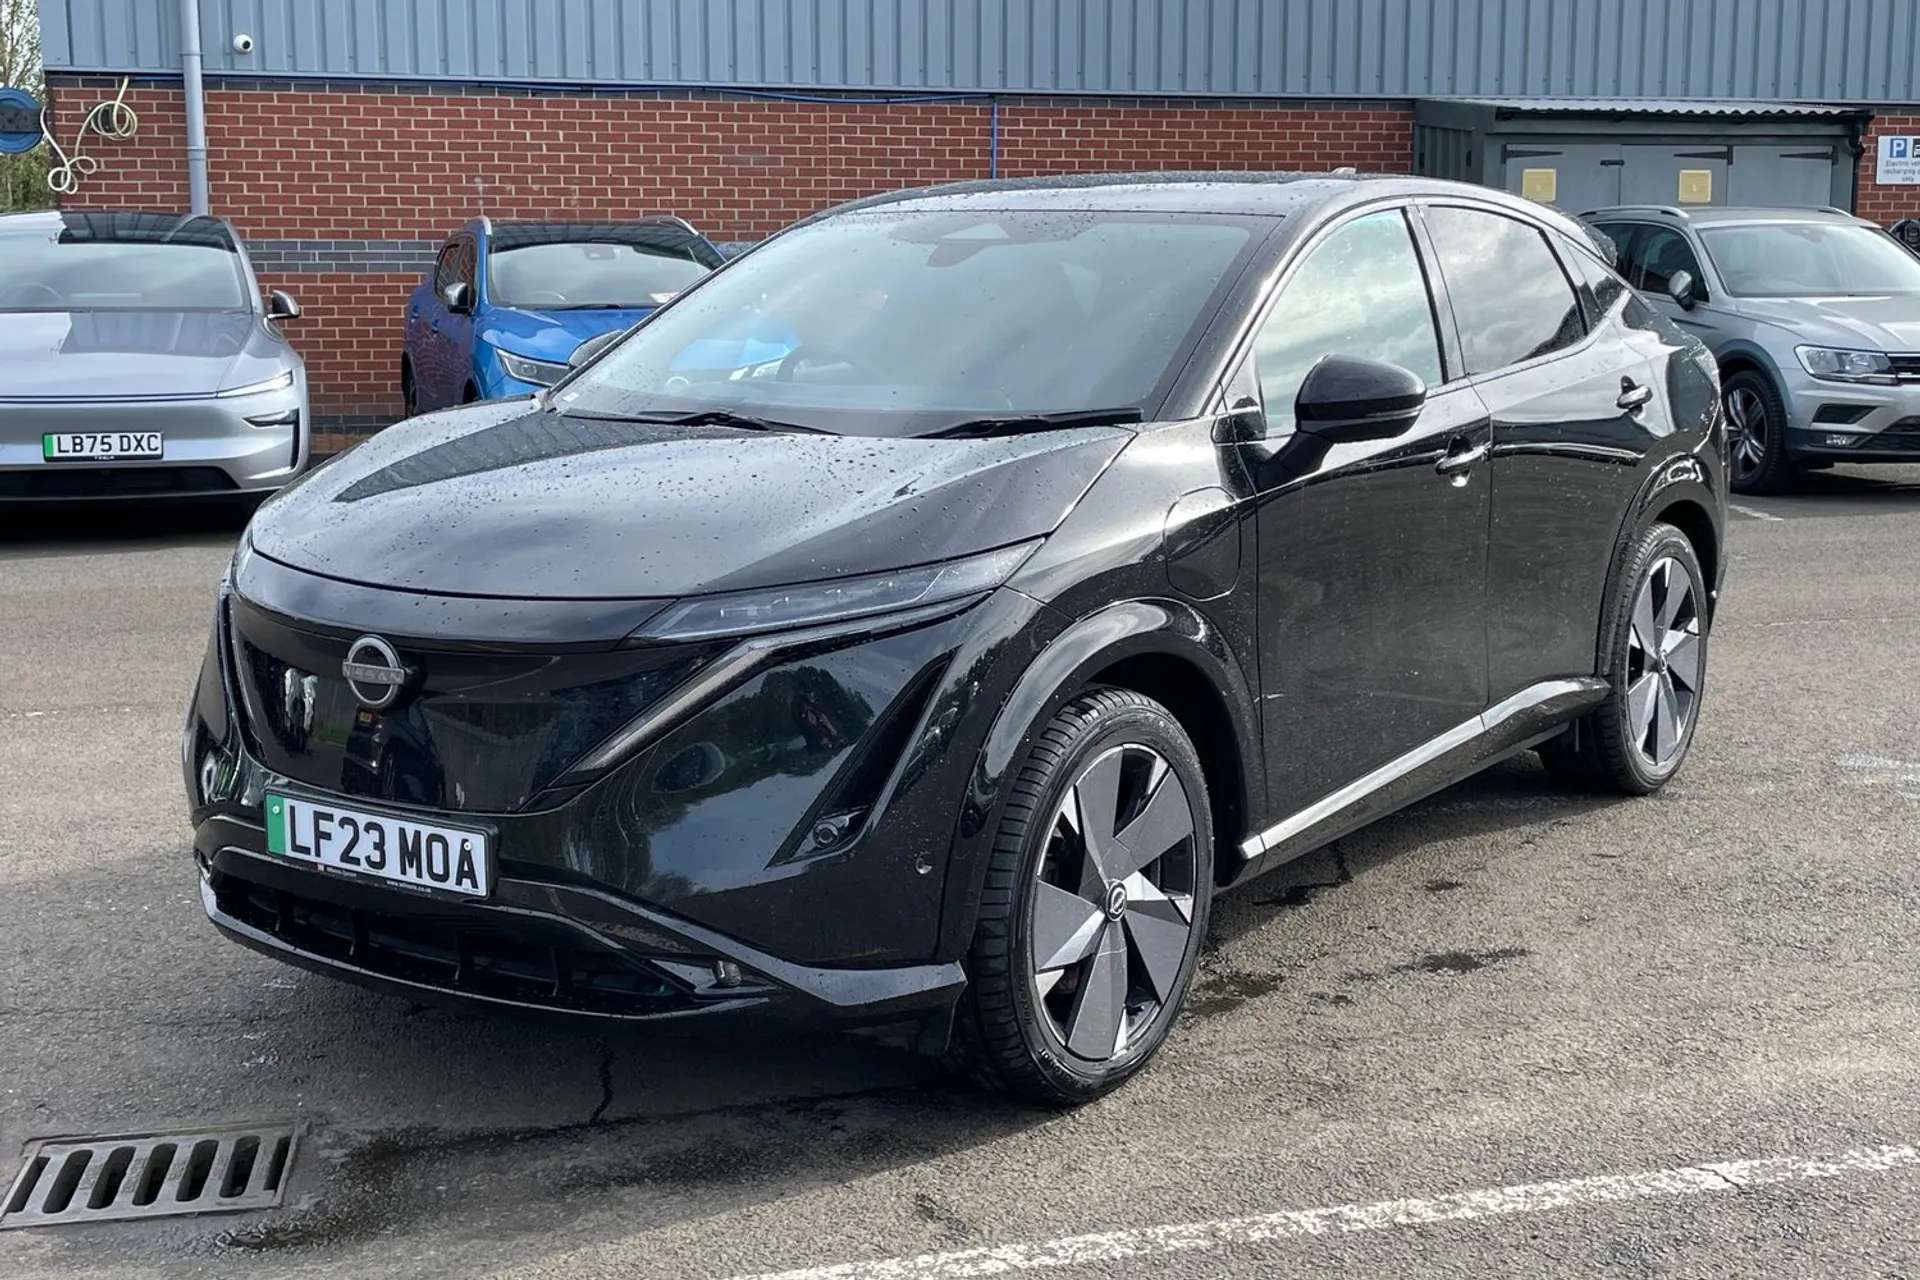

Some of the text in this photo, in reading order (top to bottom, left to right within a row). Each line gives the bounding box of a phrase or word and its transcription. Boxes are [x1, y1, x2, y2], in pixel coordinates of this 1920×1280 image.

[1893, 140, 1905, 157] P
[57, 434, 159, 453] LB75 DXC
[343, 663, 402, 682] NISSAN
[289, 805, 479, 889] LF23 MOA
